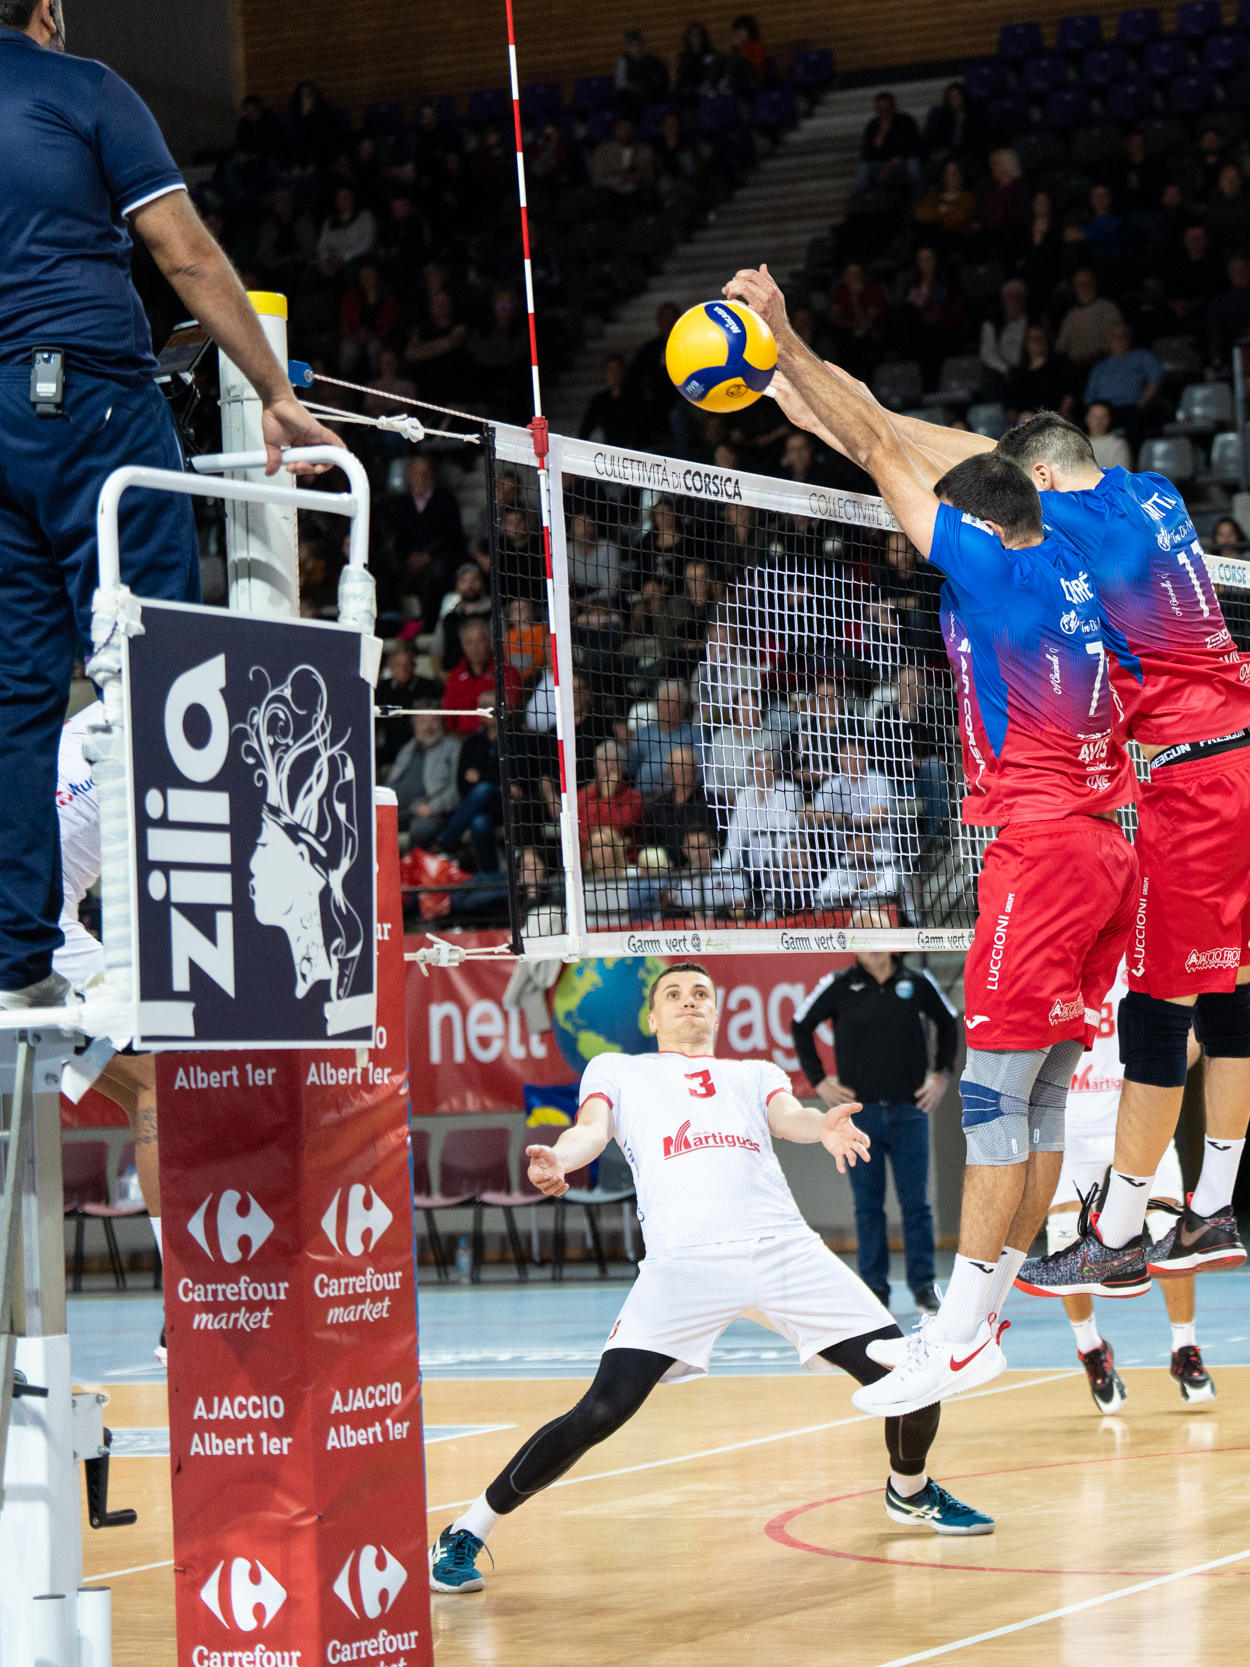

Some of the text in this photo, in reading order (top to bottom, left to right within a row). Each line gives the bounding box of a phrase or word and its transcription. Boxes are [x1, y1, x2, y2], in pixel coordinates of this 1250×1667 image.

[683, 469, 742, 501] CORSICA
[808, 491, 882, 522] COLLECTIVITÉ
[1218, 563, 1247, 585] CORSE
[960, 655, 970, 695] AIR
[1085, 640, 1106, 716] 7
[1078, 738, 1110, 764] AVIS
[145, 653, 236, 999] zilia
[627, 934, 662, 954] Gamm
[665, 934, 688, 953] vert
[781, 932, 810, 951] Gamm
[813, 931, 836, 951] vert
[917, 931, 966, 950] Gamm vert
[986, 915, 1010, 991] LUCCIONI
[173, 1063, 277, 1090] Albert 1er
[306, 1061, 392, 1086] Albert 1er
[684, 1069, 716, 1098] 3
[177, 1276, 289, 1303] Carrefour
[313, 1267, 403, 1299] Carrefour
[192, 1306, 273, 1332] market
[326, 1296, 391, 1325] market
[193, 1395, 285, 1420] AJACCIO
[330, 1382, 402, 1415] AJACCIO
[190, 1431, 293, 1457] Albert 1er
[326, 1418, 410, 1451] Albert 1er
[192, 1643, 301, 1667] Carrefour
[326, 1629, 419, 1664] Carrefour
